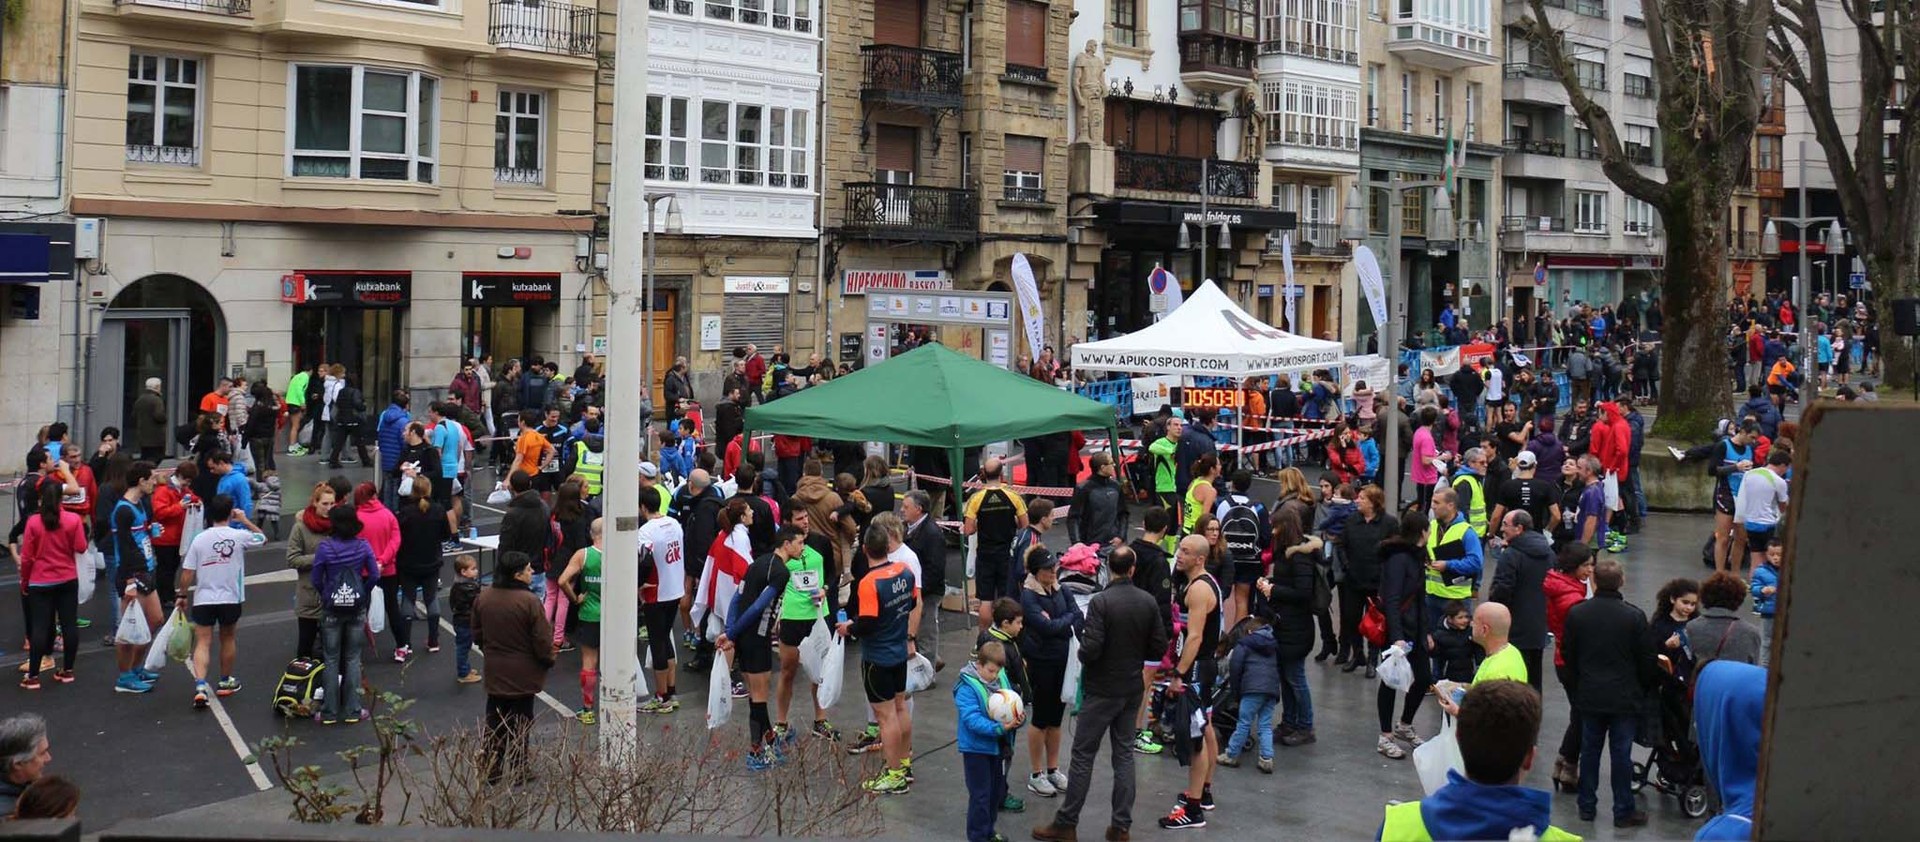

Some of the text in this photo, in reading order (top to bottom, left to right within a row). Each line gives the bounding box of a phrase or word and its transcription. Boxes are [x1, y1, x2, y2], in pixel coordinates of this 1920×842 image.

[355, 282, 401, 291] kutxabank
[512, 282, 552, 291] kutxabank
[1080, 353, 1230, 371] WWW.APUKOSPORT.COM
[1246, 351, 1339, 371] WWW.APUKOSPORT.COM
[803, 575, 810, 585] 8
